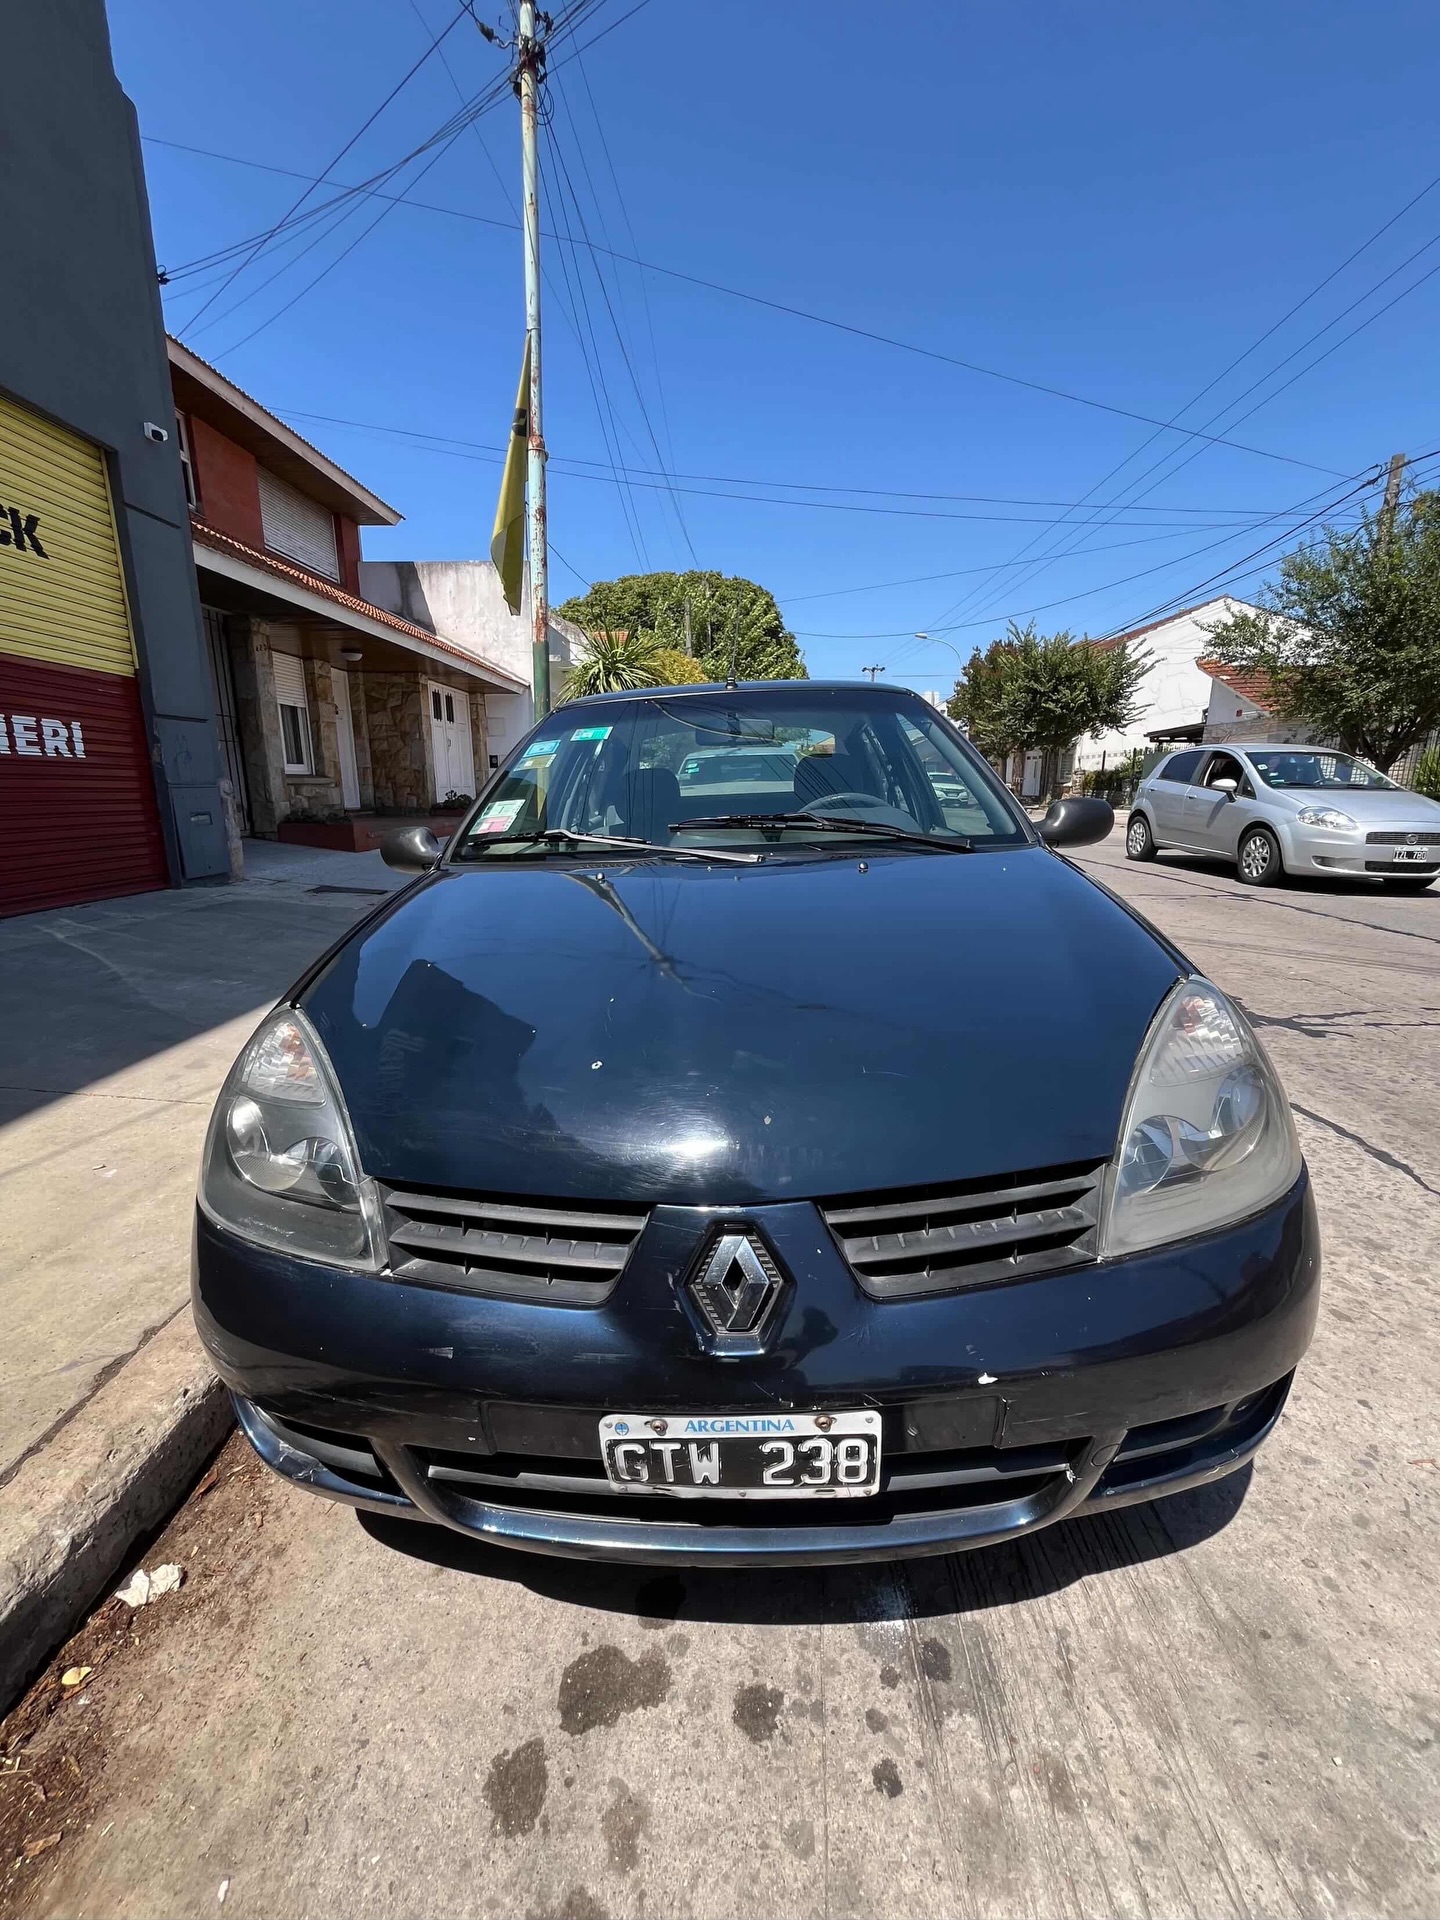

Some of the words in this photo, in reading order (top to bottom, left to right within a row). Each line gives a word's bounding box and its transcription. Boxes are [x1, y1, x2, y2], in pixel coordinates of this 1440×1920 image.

[685, 1419, 795, 1433] ARGENTINA
[614, 1441, 720, 1485] GTW
[762, 1438, 869, 1485] 238
